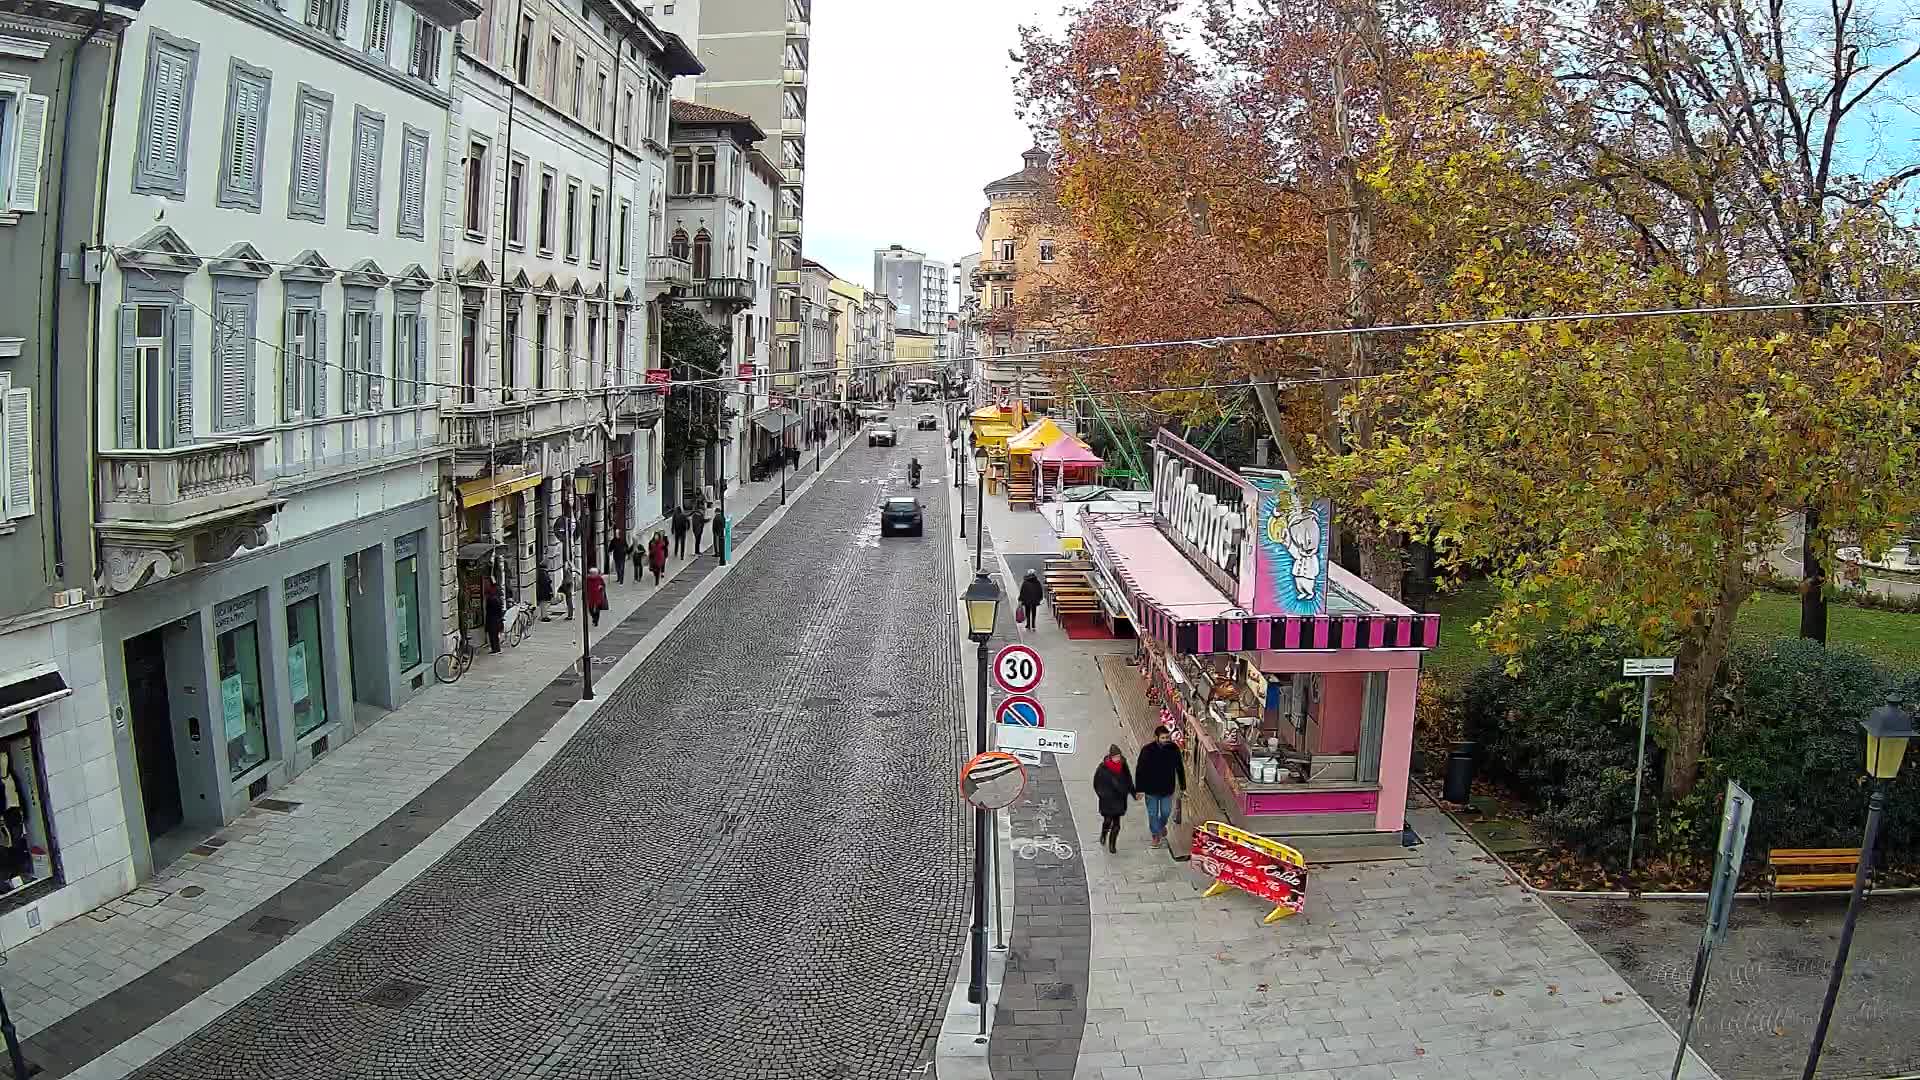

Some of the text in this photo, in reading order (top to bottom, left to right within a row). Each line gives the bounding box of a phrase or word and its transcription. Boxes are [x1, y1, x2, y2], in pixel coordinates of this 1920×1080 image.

[1005, 658, 1033, 680] 30
[1038, 737, 1070, 750] Dante
[1255, 864, 1301, 886] Calde
